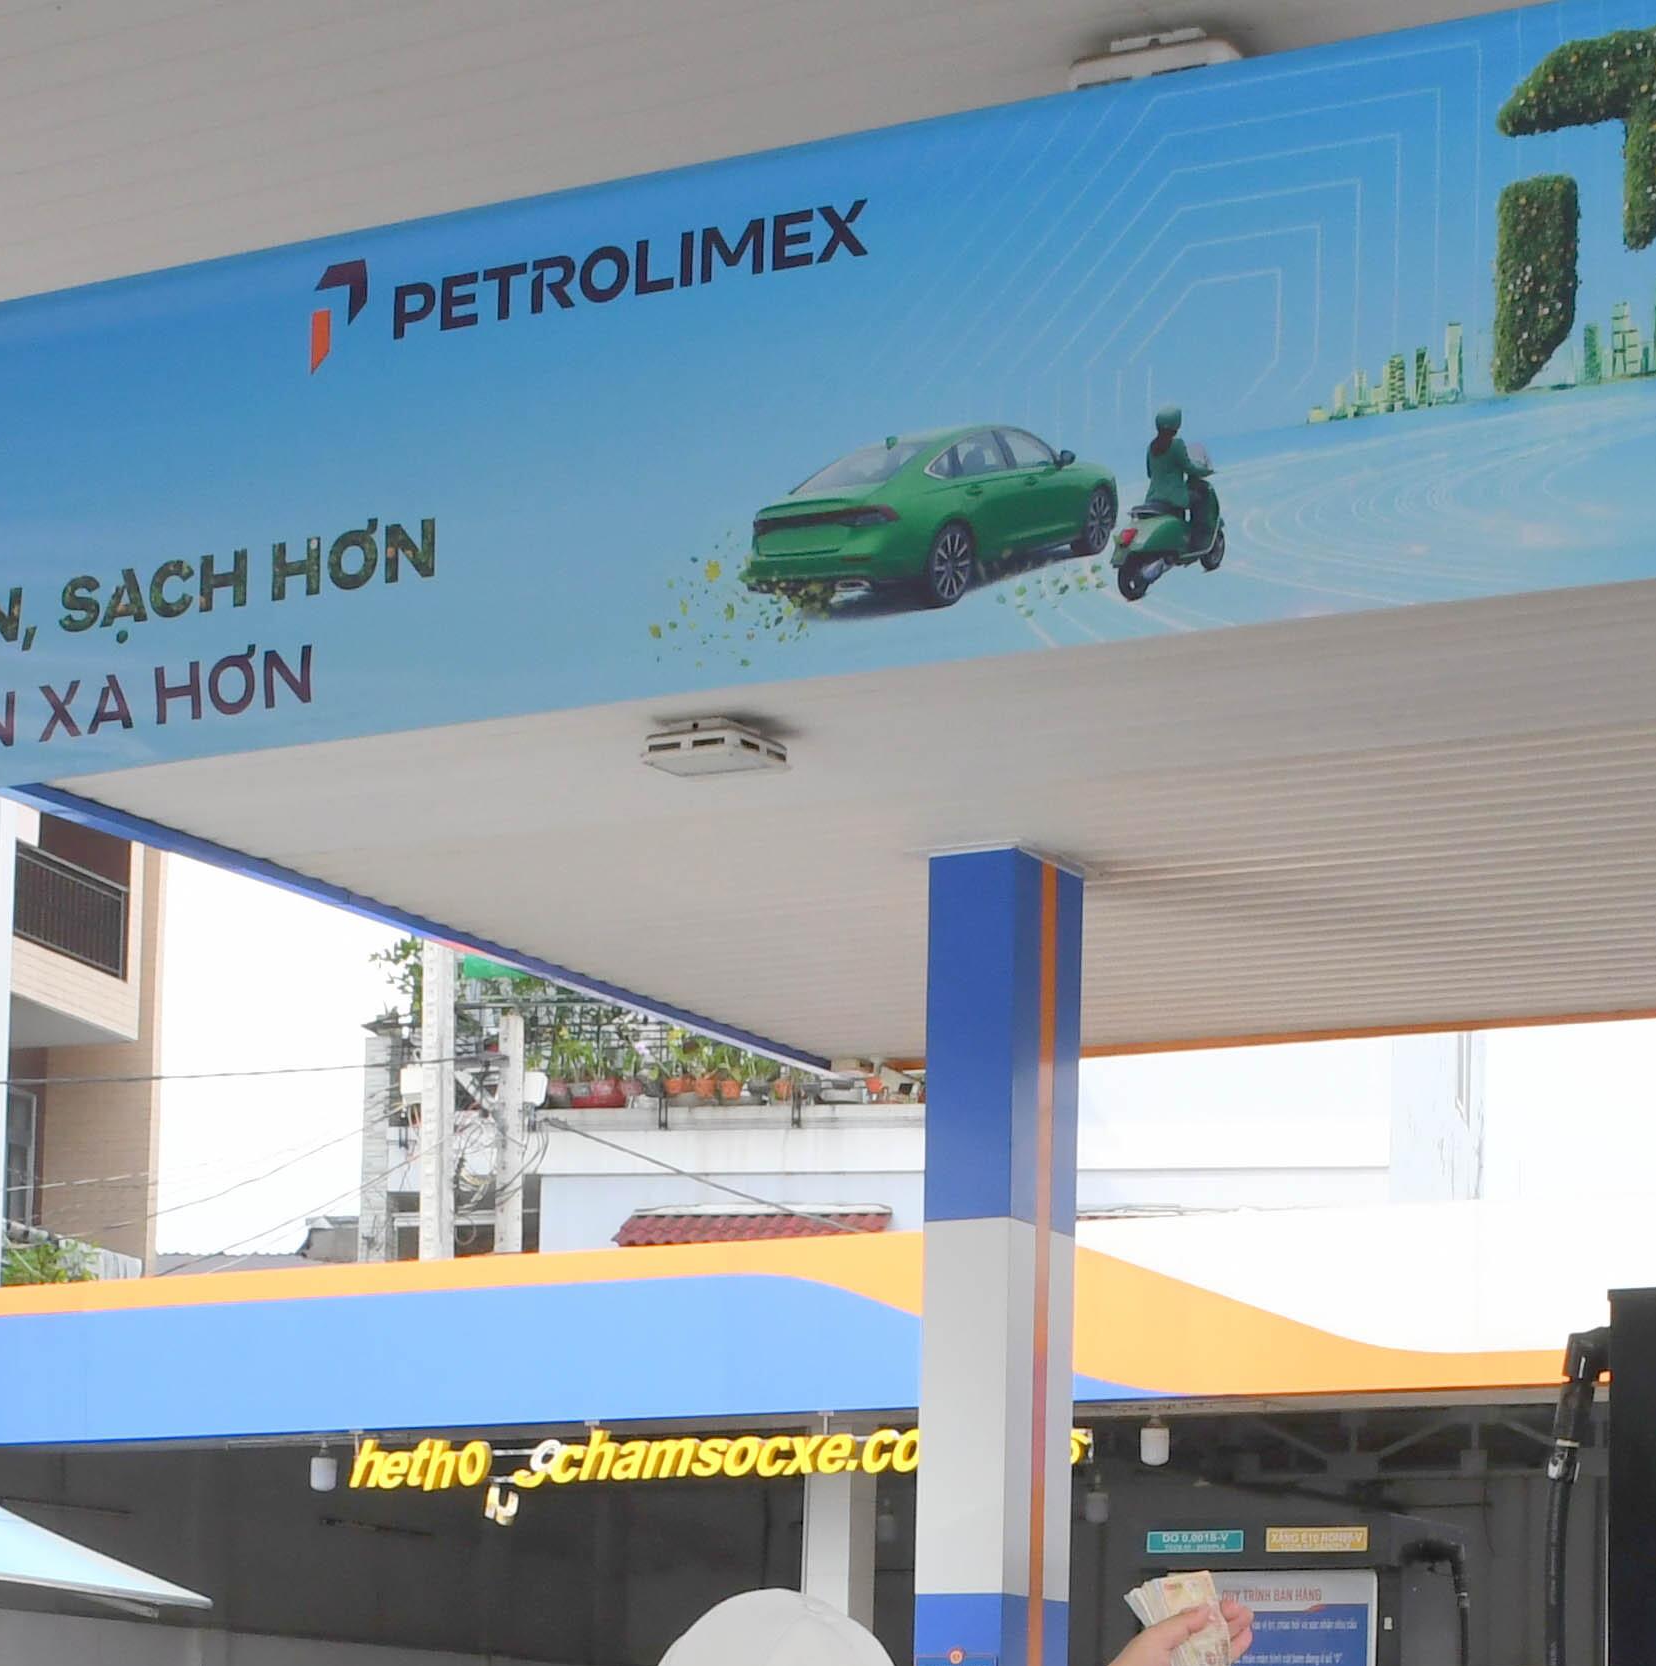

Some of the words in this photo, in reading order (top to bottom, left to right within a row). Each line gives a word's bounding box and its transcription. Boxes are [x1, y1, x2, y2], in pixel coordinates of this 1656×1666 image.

[392, 198, 868, 341] PETROLIMEX
[59, 548, 249, 644] SẠCH
[271, 517, 436, 601] HƠN
[38, 673, 132, 743] XA
[154, 644, 313, 725] HƠN
